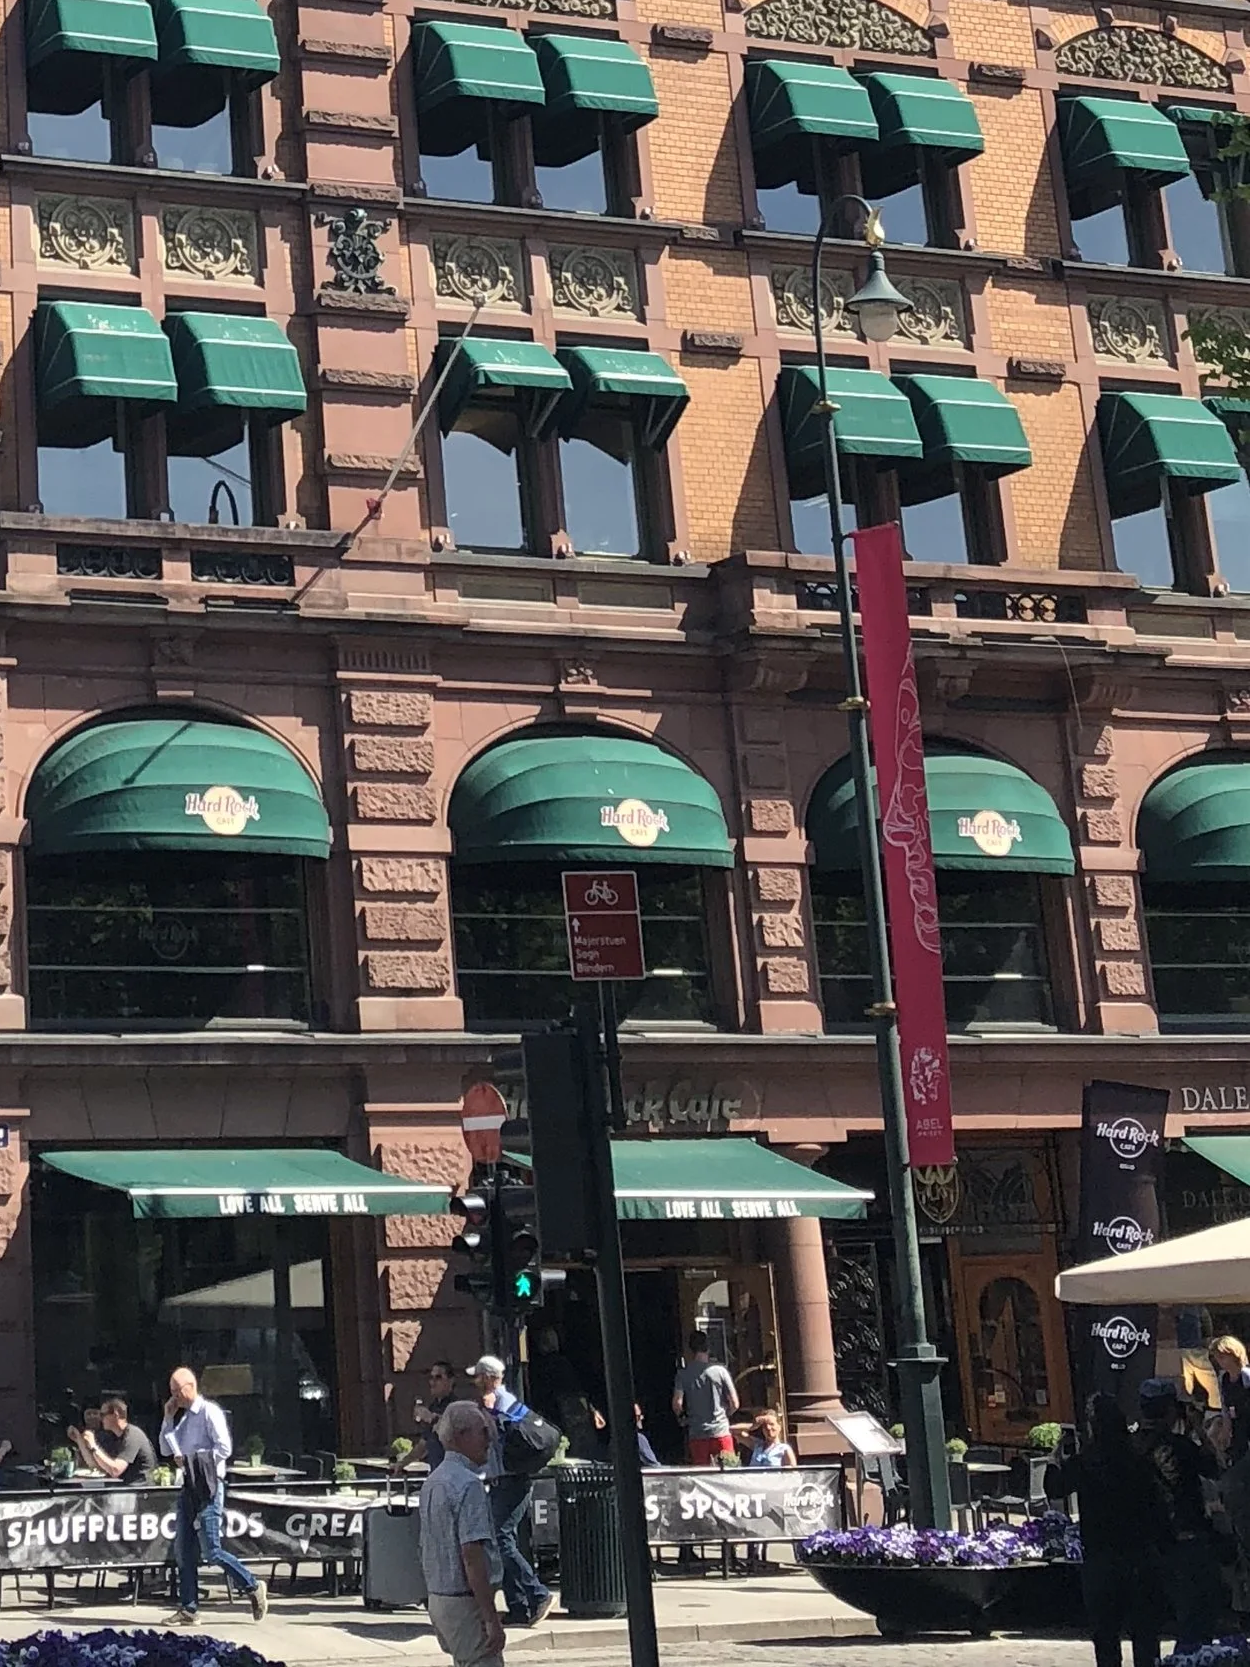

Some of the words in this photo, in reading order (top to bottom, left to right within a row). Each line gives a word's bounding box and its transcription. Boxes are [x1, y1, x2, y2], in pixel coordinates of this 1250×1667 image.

[185, 793, 221, 814] Hard
[225, 795, 260, 821] Rock
[601, 806, 634, 826] Hard
[637, 807, 670, 832] Rock
[958, 817, 990, 837] Hard
[992, 819, 1023, 842] Rock
[576, 949, 600, 960] Sogn
[577, 962, 615, 973] Blindern
[1181, 1086, 1250, 1111] DALE
[916, 1117, 944, 1130] ABEL
[1096, 1122, 1128, 1140] Hard
[1129, 1127, 1159, 1147] Rock
[218, 1194, 254, 1214] LOVE
[259, 1194, 285, 1213] ALL
[293, 1194, 338, 1213] SERVE
[343, 1194, 368, 1213] ALL
[665, 1200, 696, 1218] LOVE
[701, 1200, 724, 1218] ALL
[731, 1200, 774, 1218] SERVE
[776, 1200, 801, 1217] ALL
[1093, 1222, 1124, 1239] Hard
[1125, 1225, 1154, 1245] Rock
[1091, 1322, 1119, 1338] Hard
[1120, 1325, 1150, 1345] Rock
[680, 1493, 767, 1520] SPORT
[783, 1492, 810, 1507] Hard
[7, 1512, 264, 1548] SHUFFLEBODS
[285, 1513, 364, 1537] GREA
